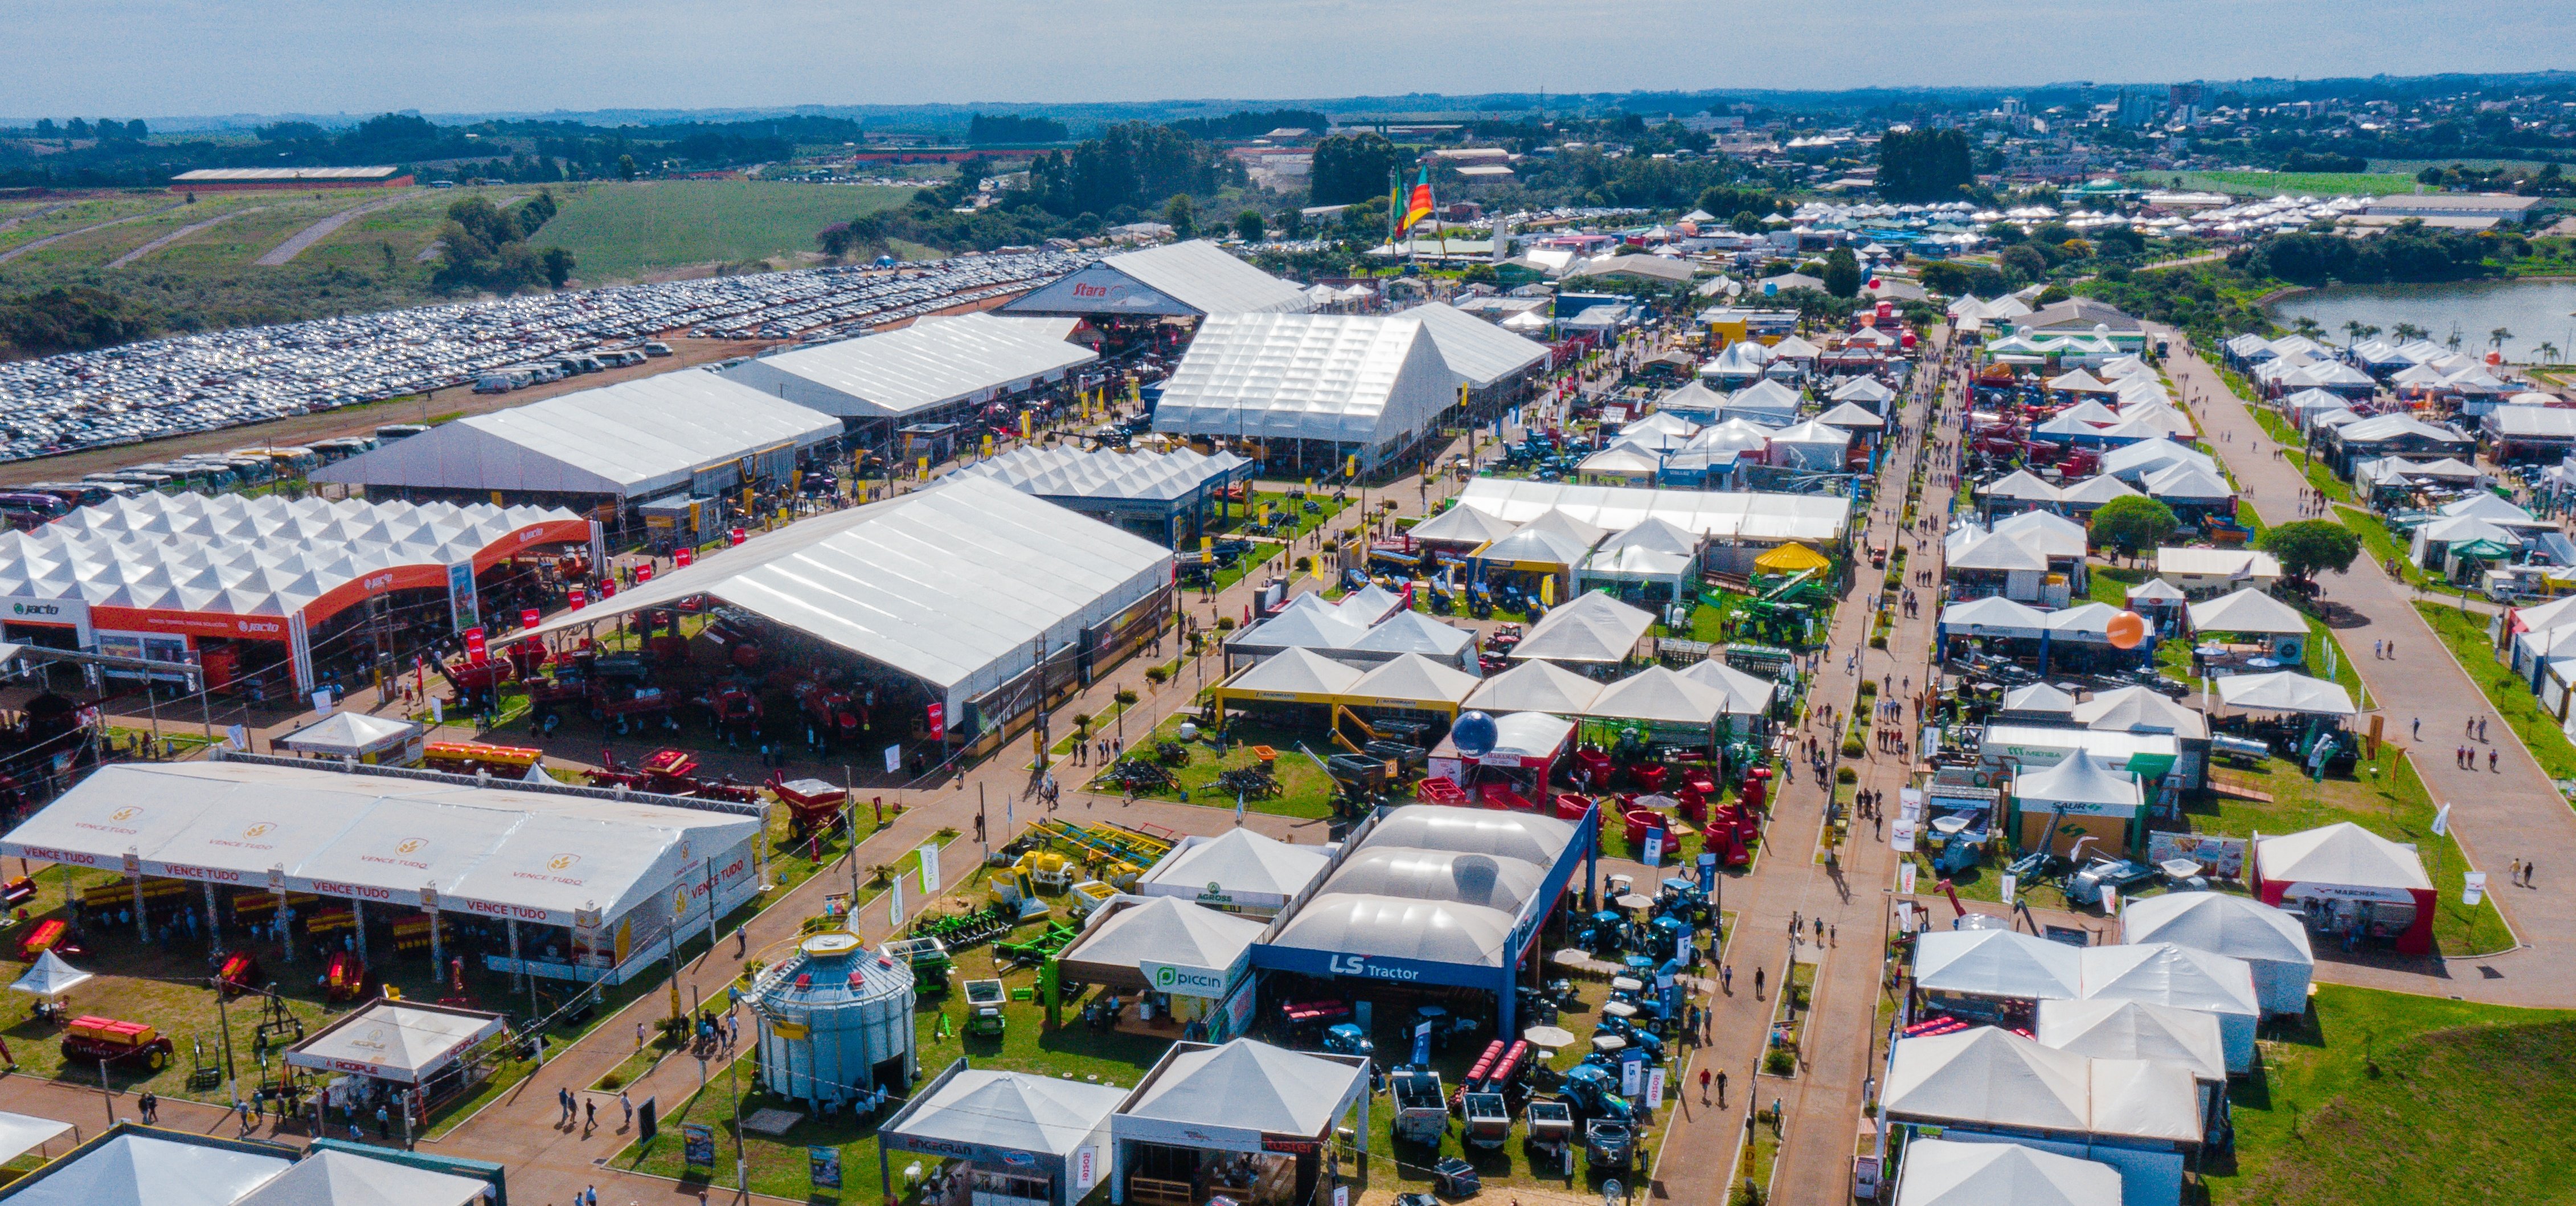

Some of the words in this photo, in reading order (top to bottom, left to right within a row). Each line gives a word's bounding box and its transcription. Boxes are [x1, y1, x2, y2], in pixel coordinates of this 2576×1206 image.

[1073, 283, 1106, 297] Stara
[25, 604, 59, 615] jacto
[248, 622, 279, 633] jacto
[2051, 801, 2086, 810] SAUR
[75, 822, 105, 832] VENCE
[209, 839, 243, 848] VENCE
[23, 847, 60, 860] VENCE
[63, 852, 95, 864] TUDO
[361, 855, 395, 864] VENCE
[398, 860, 427, 869] TUDO
[166, 864, 203, 878] VENCE
[206, 869, 239, 881] TUDO
[720, 859, 743, 881] TUDO
[513, 872, 547, 881] VENCE
[550, 876, 582, 886] TUDO
[313, 881, 353, 895] VENCE
[355, 885, 390, 900] TUDO
[1197, 893, 1232, 902] AGROSS
[466, 900, 509, 915] VENCE
[513, 905, 547, 920] TUDO
[1330, 955, 1365, 974] LS
[1368, 965, 1419, 980] Tractor
[1178, 974, 1221, 988] piccin
[1652, 1074, 1661, 1102] Roster
[1263, 1138, 1313, 1154] Roster
